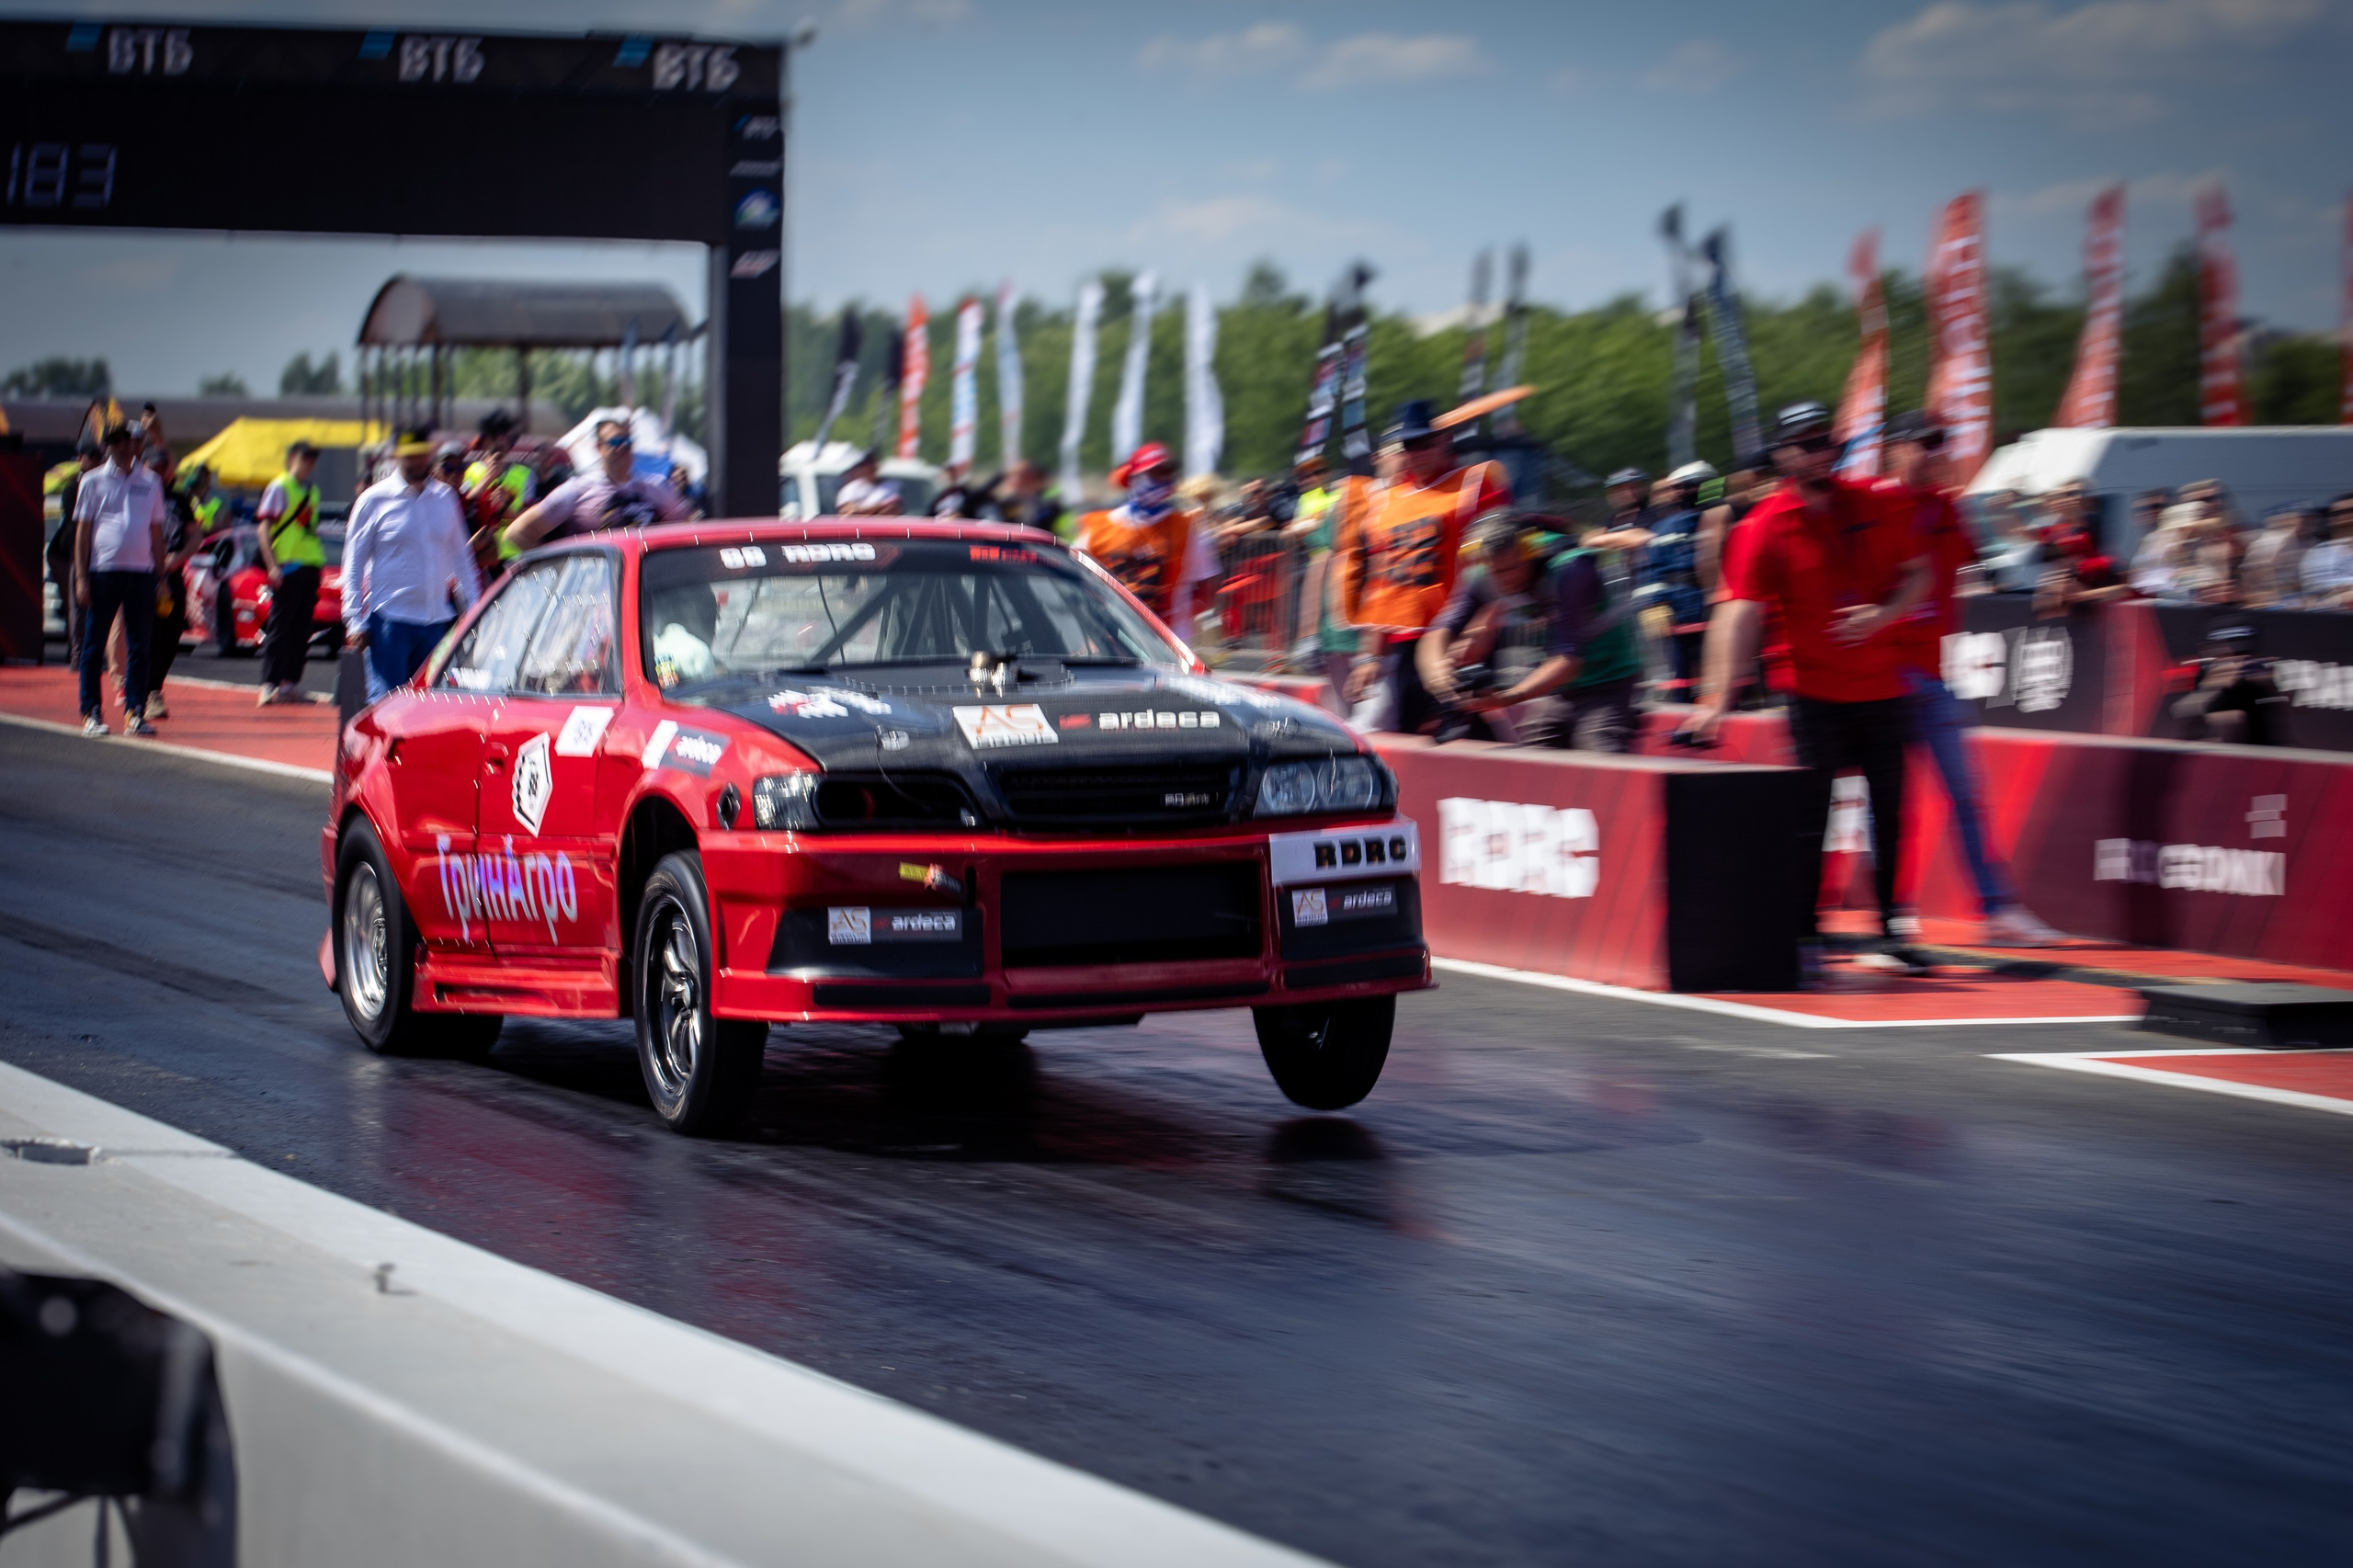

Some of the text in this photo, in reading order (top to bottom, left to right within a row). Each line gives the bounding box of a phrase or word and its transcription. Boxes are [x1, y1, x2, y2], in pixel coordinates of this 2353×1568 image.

[1098, 709, 1221, 729] ardeca
[1313, 834, 1407, 871] RDRC
[1343, 890, 1392, 911] ardeca
[892, 913, 957, 932] ardeca
